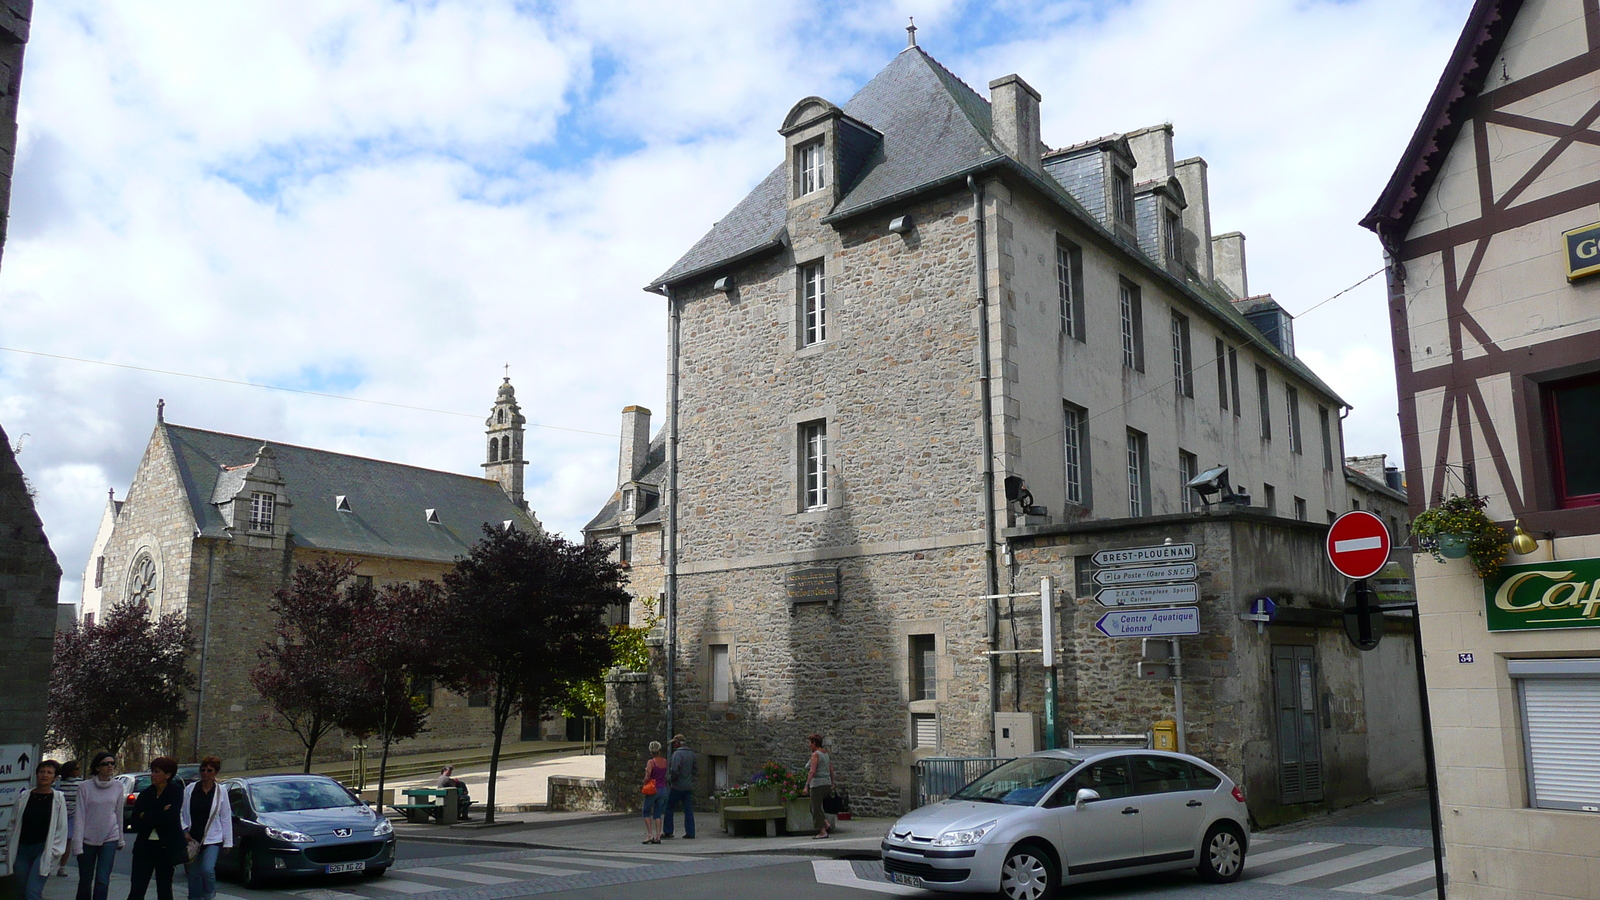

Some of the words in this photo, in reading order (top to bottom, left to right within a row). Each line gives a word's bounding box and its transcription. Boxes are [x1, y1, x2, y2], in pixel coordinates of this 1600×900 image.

[1576, 238, 1600, 259] G
[1102, 547, 1190, 562] BREST-PLOUÉNAN
[1123, 571, 1141, 579] Poste
[1172, 586, 1194, 594] Sportif
[1120, 615, 1147, 623] Centre
[1152, 613, 1194, 623] Aquatique
[1121, 624, 1153, 633] Léonard
[1460, 653, 1472, 663] 34
[355, 862, 363, 870] 22
